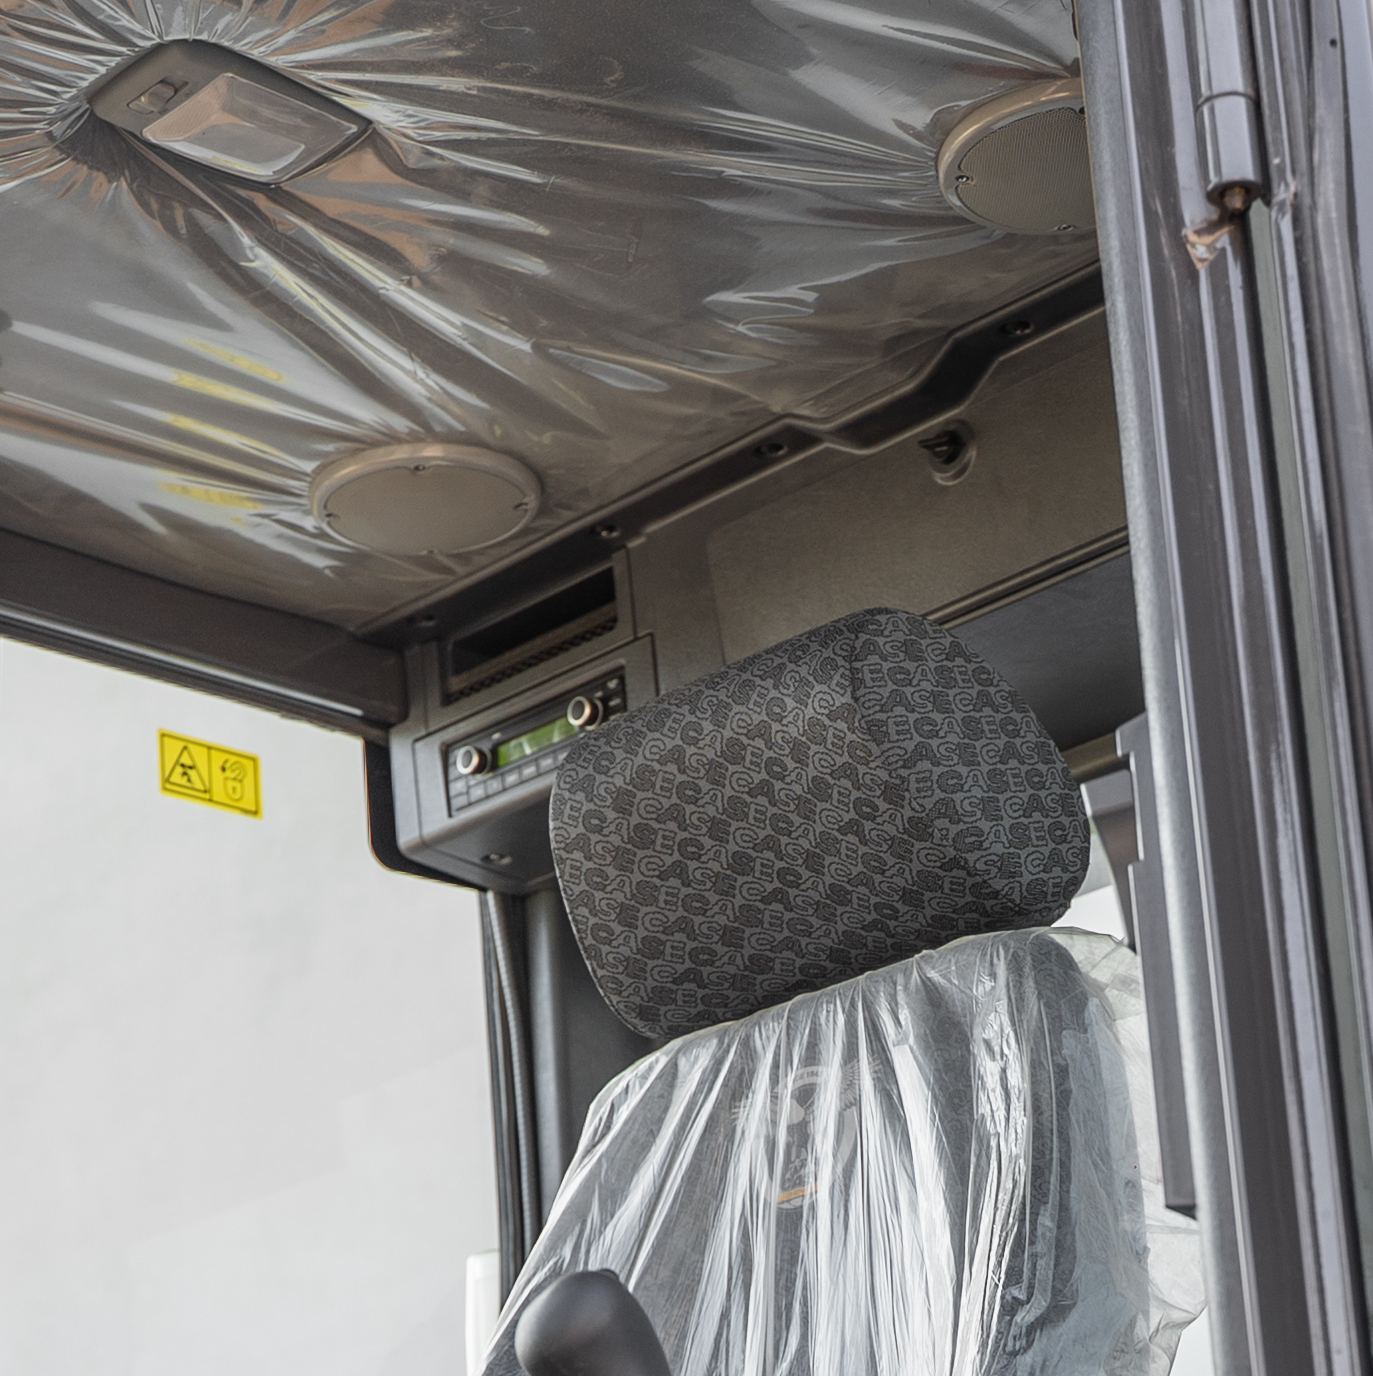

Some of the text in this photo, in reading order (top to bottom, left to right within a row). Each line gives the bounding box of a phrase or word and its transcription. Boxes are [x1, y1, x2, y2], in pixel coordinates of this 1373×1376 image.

[864, 615, 947, 639] CASE
[887, 664, 974, 688] CASE
[765, 698, 845, 749] CASE
[859, 690, 955, 714] CASE
[681, 721, 763, 773] CASE
[730, 712, 810, 766] CASE
[914, 716, 1001, 739] CASE
[593, 752, 674, 797] CASE
[642, 738, 727, 787] CASE
[980, 741, 1056, 765] CASE
[557, 769, 636, 815] CASE
[729, 770, 817, 816] CASE
[765, 756, 851, 812] CASE
[812, 751, 905, 808] CASE
[936, 768, 1028, 793] CASE
[637, 798, 730, 844] CASE
[676, 780, 768, 829] CASE
[1003, 795, 1077, 818] CASE
[583, 808, 676, 855] CASE
[732, 827, 826, 876] CASE
[768, 812, 858, 864] CASE
[819, 808, 913, 862] CASE
[638, 855, 737, 898] CASE
[677, 837, 775, 883] CASE
[860, 852, 966, 897] CASE
[583, 867, 681, 911] CASE
[739, 881, 837, 923] CASE
[776, 866, 871, 915] CASE
[828, 861, 926, 909] CASE
[641, 911, 745, 948] CASE
[681, 893, 784, 932] CASE
[590, 922, 686, 964] CASE
[688, 946, 796, 977] CASE
[748, 932, 852, 965] CASE
[650, 964, 757, 992] CASE
